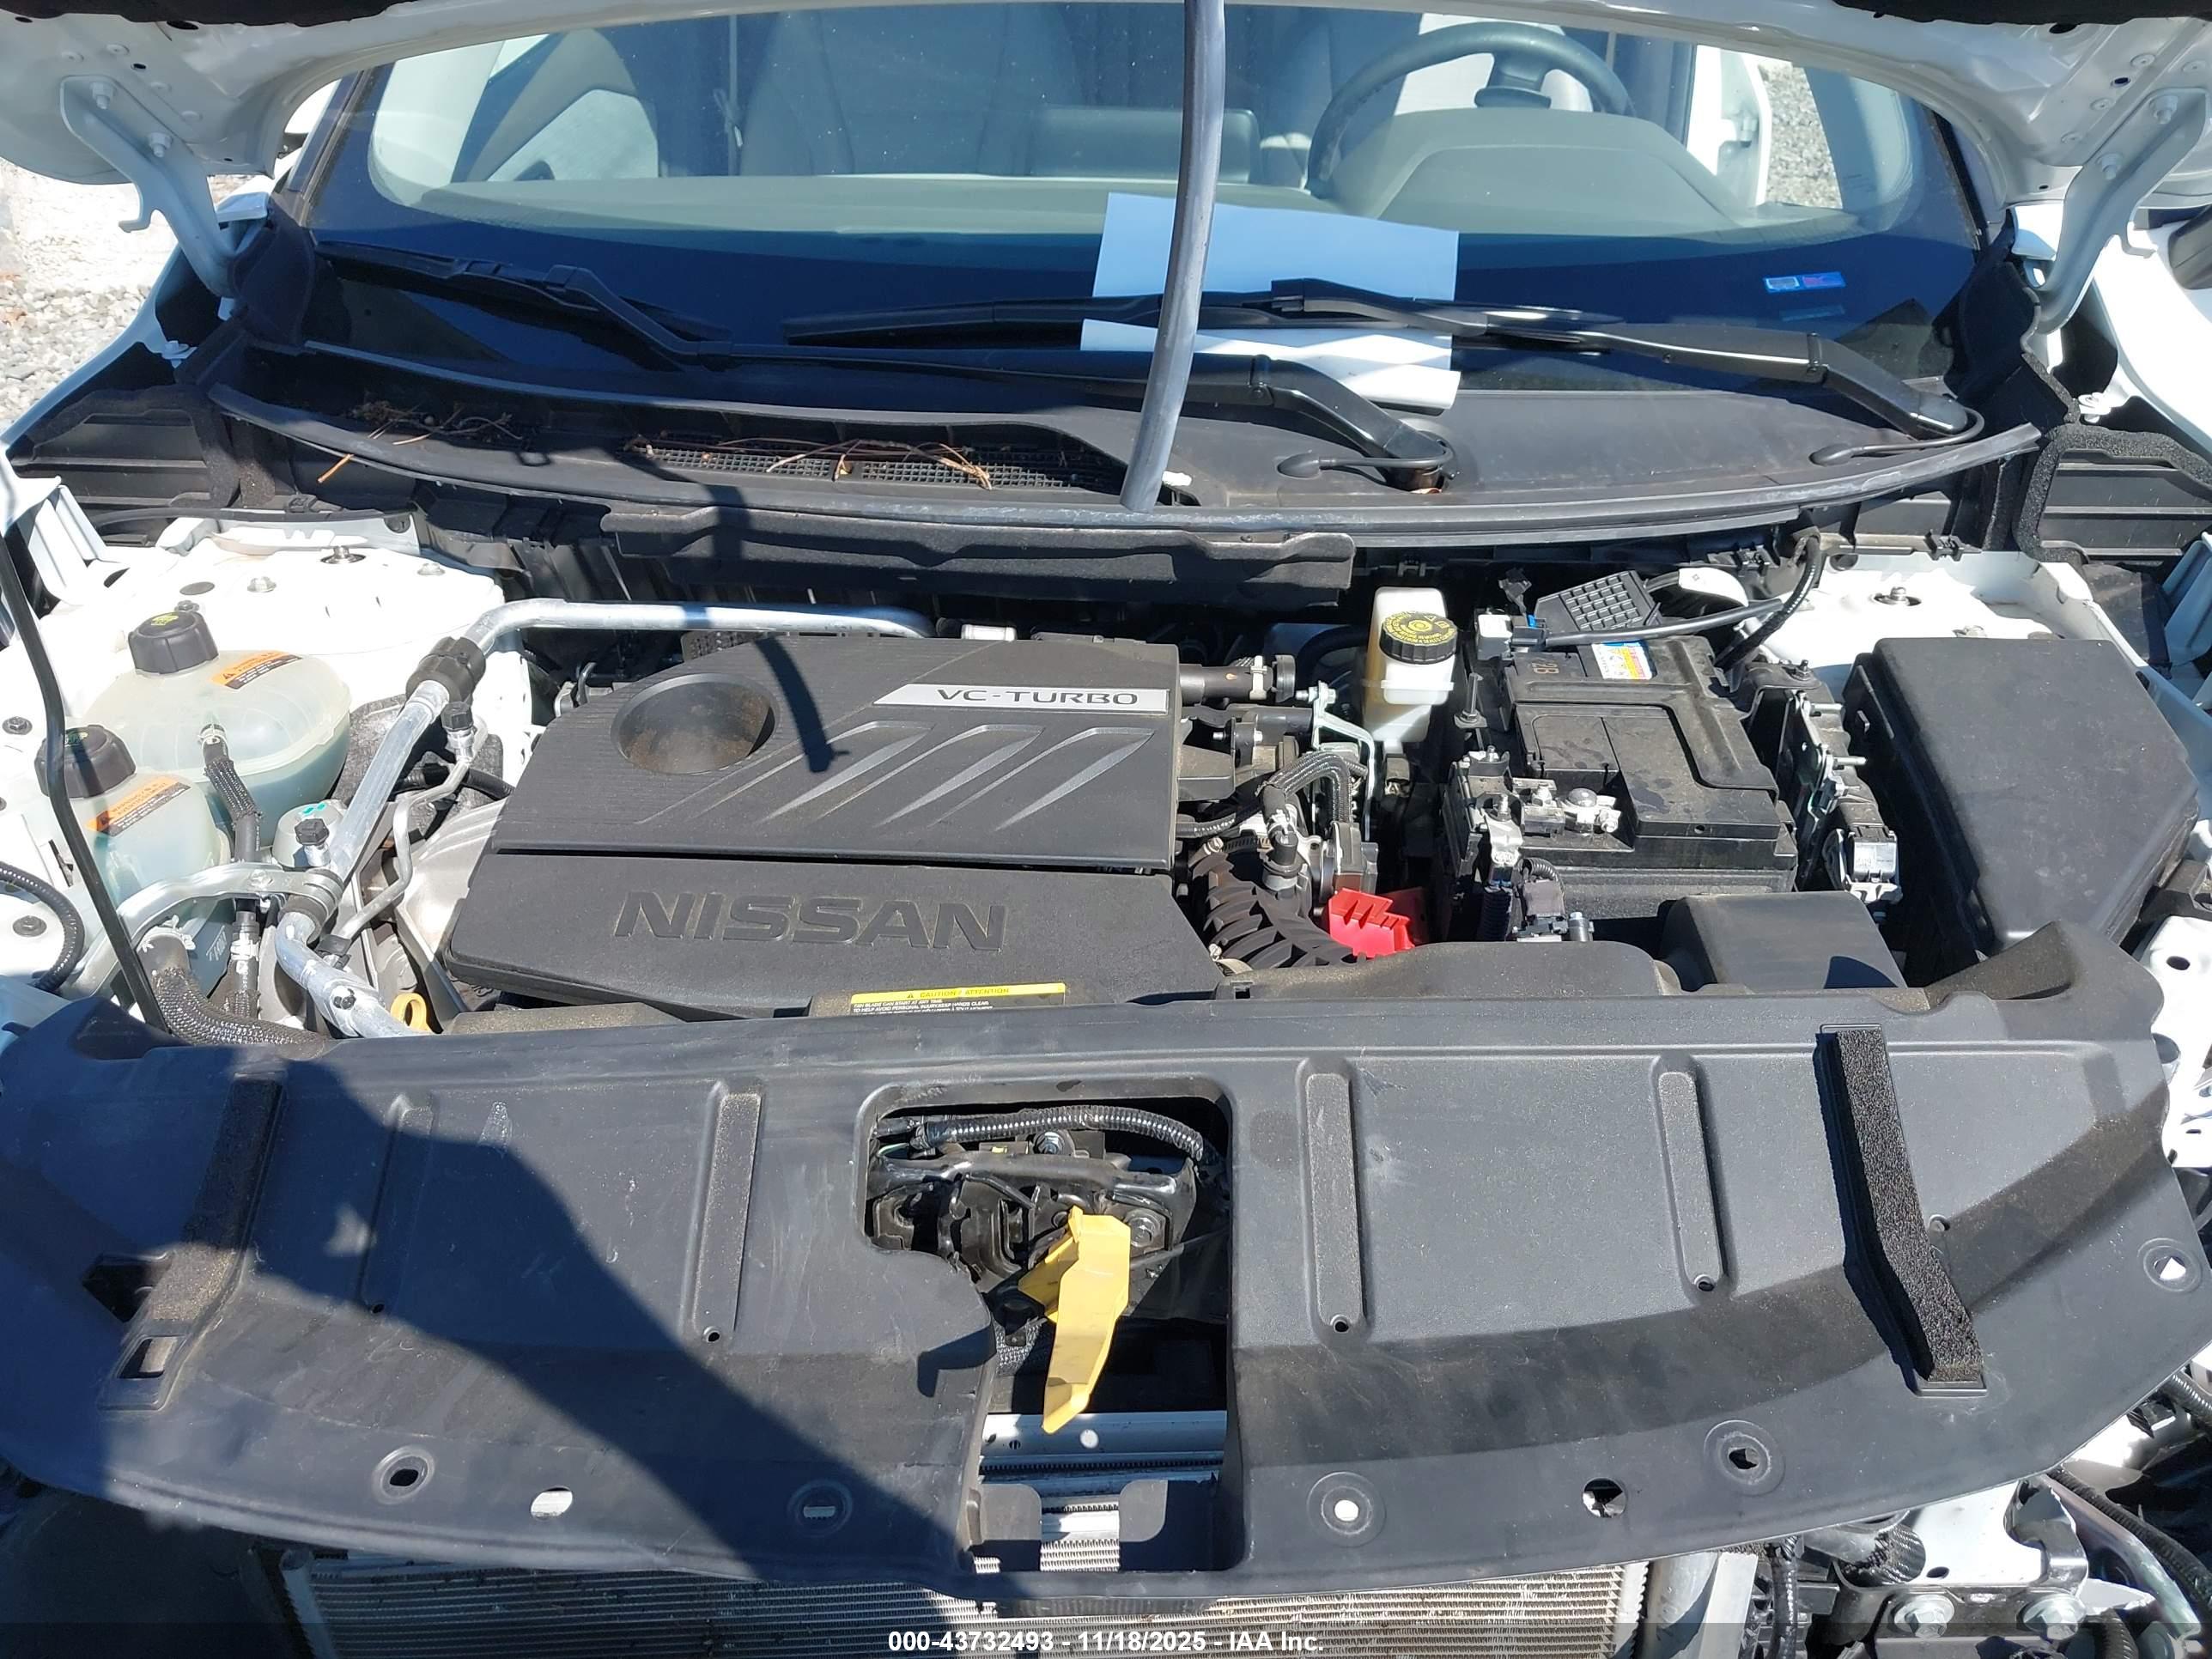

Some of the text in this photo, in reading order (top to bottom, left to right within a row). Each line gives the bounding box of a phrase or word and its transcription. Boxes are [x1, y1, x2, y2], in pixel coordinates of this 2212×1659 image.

[937, 689, 1138, 705] VC-TURBO
[613, 891, 1006, 952] NISSAN
[920, 990, 956, 999] CAUTION
